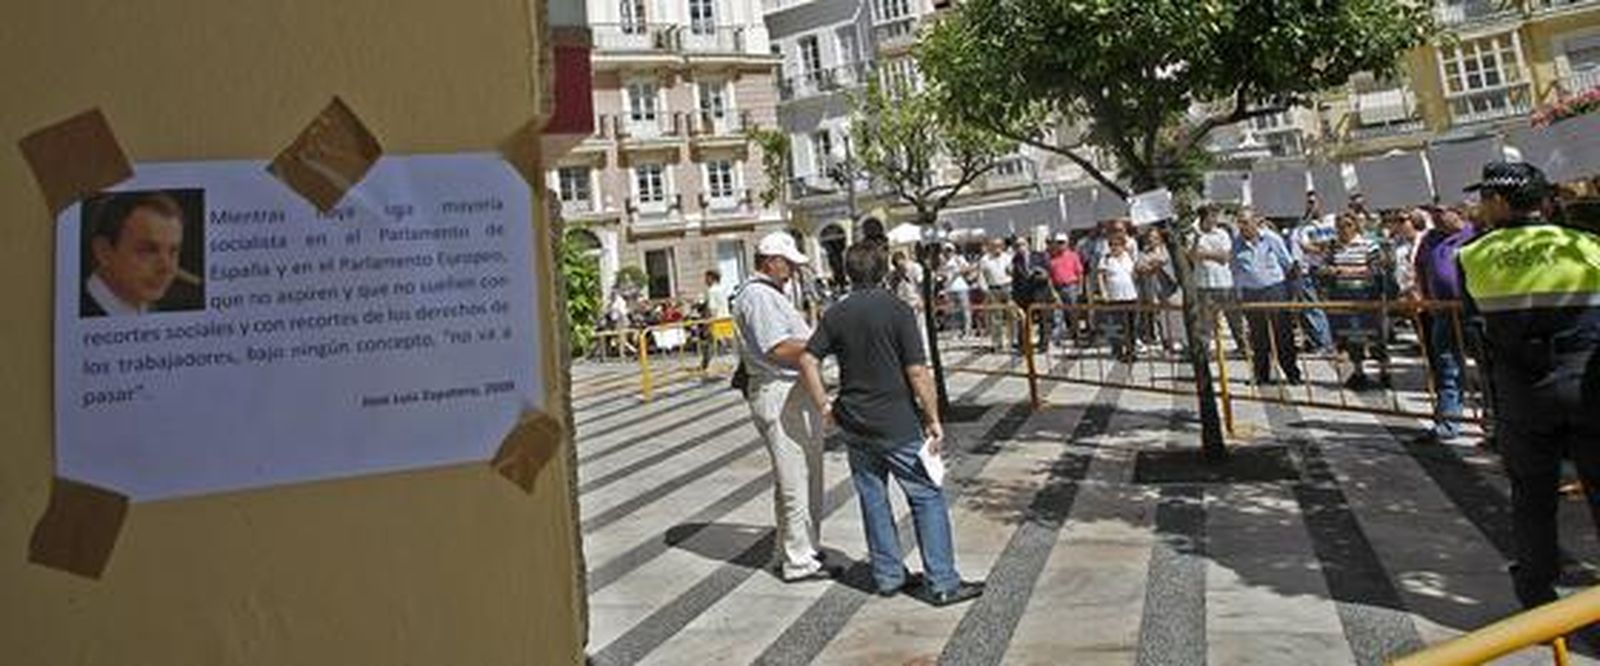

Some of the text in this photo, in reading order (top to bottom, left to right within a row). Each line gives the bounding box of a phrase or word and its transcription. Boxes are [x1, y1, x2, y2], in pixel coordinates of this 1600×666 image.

[210, 210, 285, 226] Mientras
[209, 223, 504, 252] socialista en el Parlamento de
[210, 262, 269, 282] España
[275, 265, 287, 279] y
[291, 262, 313, 274] en
[319, 258, 335, 271] el
[340, 253, 434, 271] Parlamento
[210, 295, 244, 314] que
[250, 293, 272, 306] no
[276, 286, 338, 306] aspiren
[342, 285, 353, 299] y
[357, 282, 389, 299] que
[394, 281, 416, 295] no
[479, 275, 508, 289] con
[84, 298, 509, 345] recortes sociales y con recortes de los derechos de
[82, 358, 110, 376] los
[118, 349, 241, 374] trabajadores,
[247, 344, 284, 363] bajo
[290, 341, 350, 358] ningún
[477, 327, 495, 341] va
[501, 326, 513, 339] a
